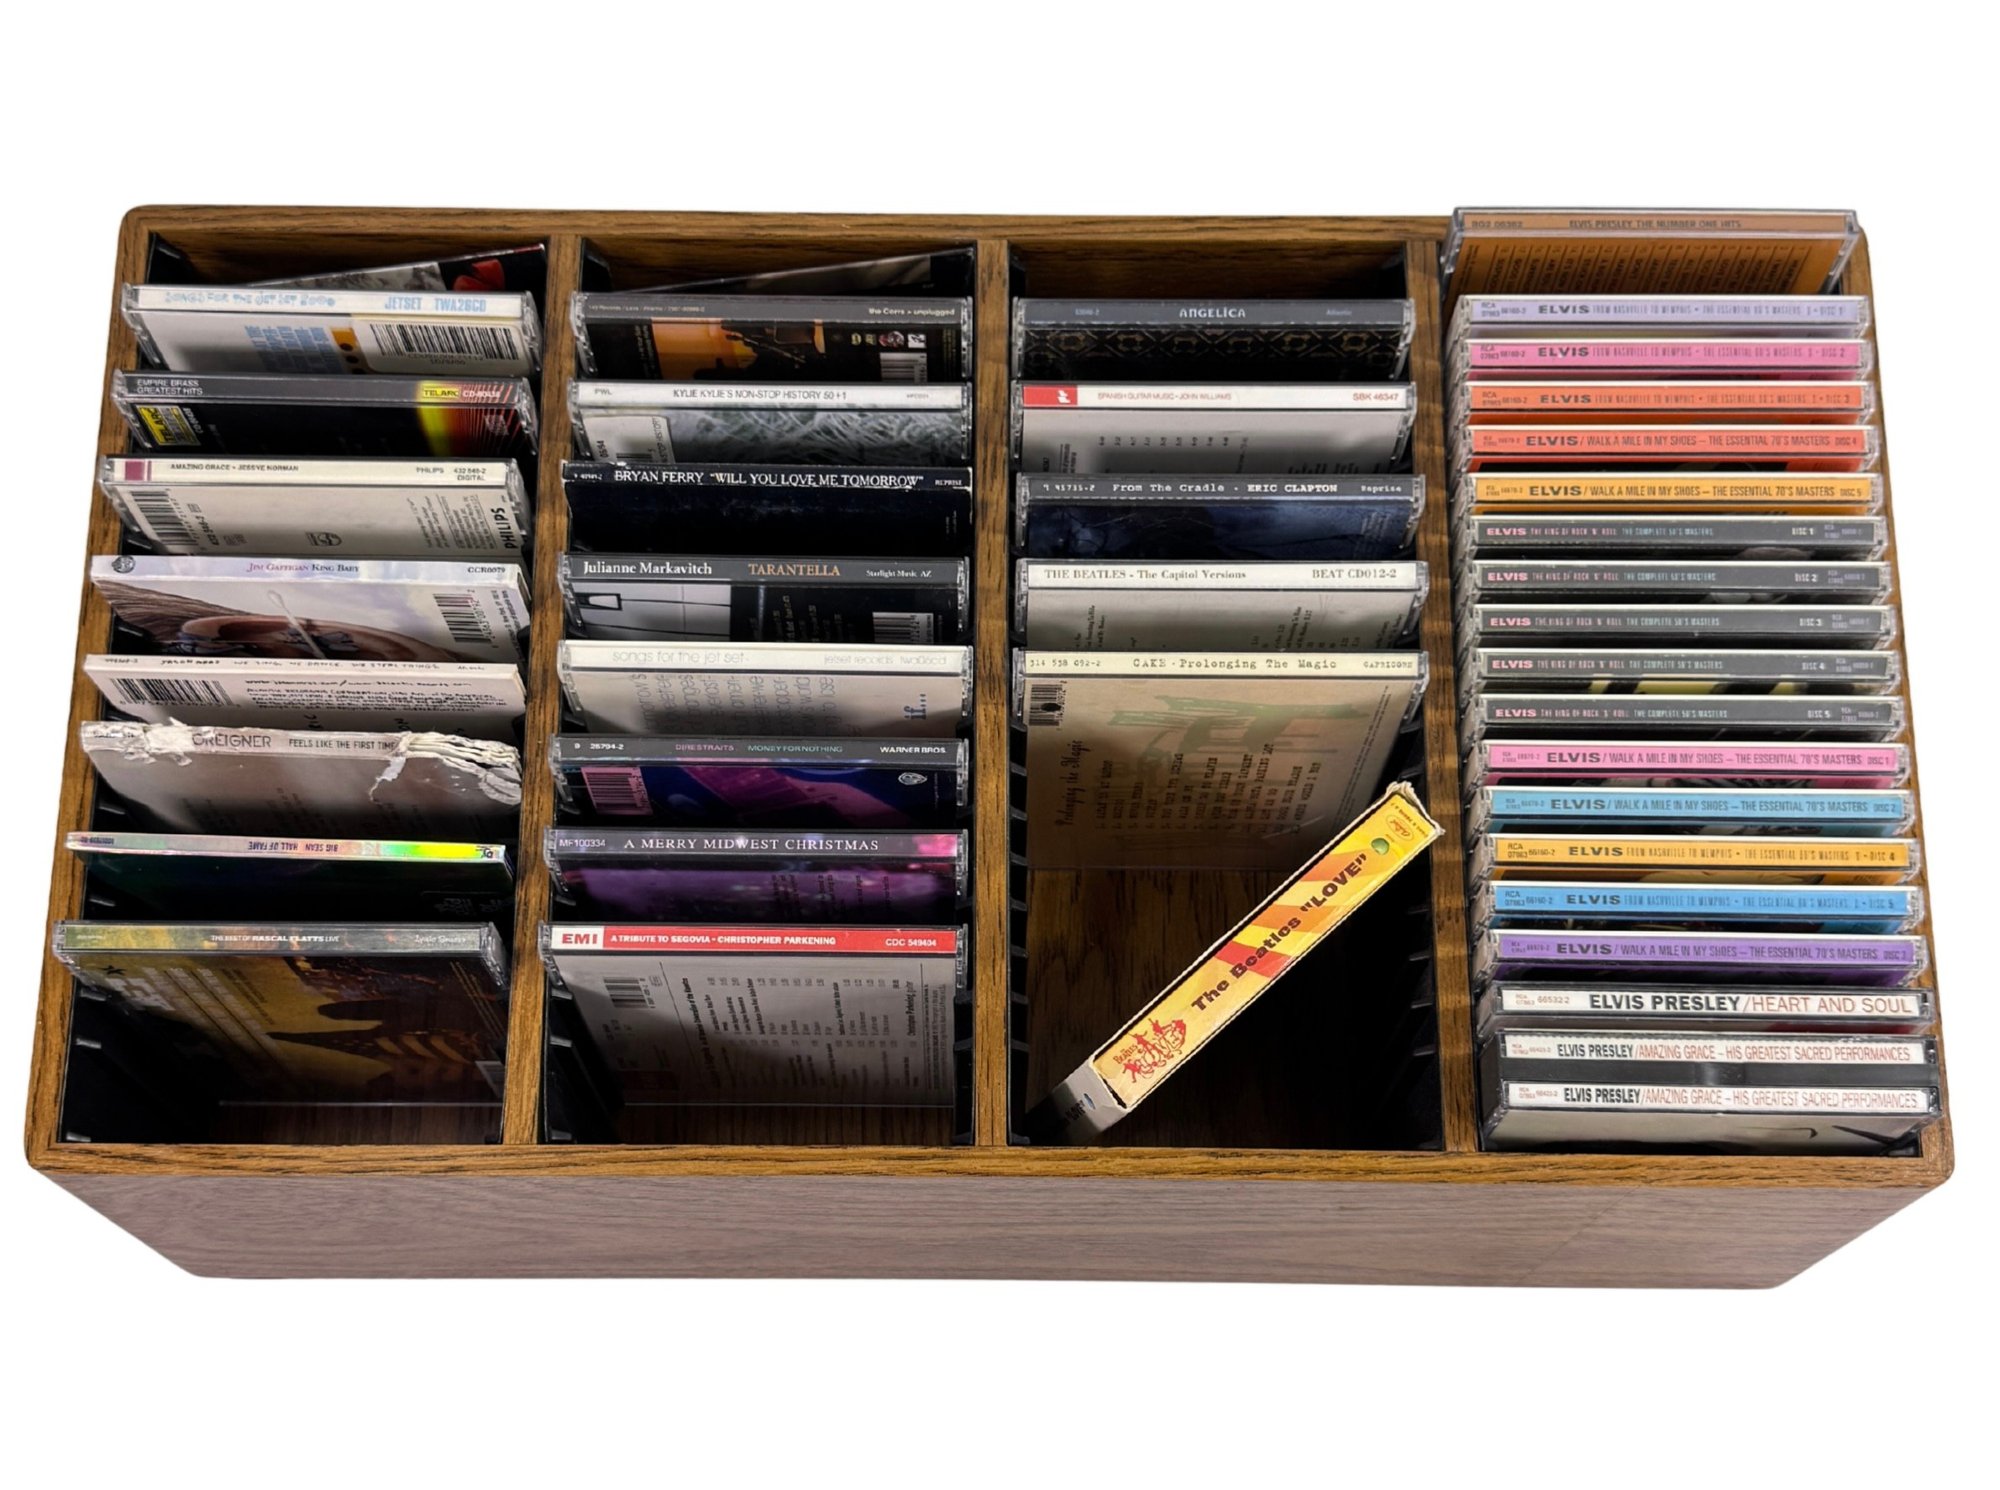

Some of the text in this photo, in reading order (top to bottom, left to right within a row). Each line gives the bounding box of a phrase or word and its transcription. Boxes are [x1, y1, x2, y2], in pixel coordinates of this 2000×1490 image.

[1595, 220, 1632, 228] PRESLEY
[384, 296, 422, 311] JETSET
[883, 307, 905, 315] Corrs
[913, 307, 955, 317] unplugged
[1538, 304, 1590, 315] ELVIS
[137, 378, 199, 388] EMPIRE BRASS
[136, 386, 203, 396] GREATEST HITS
[423, 389, 459, 398] TELARC
[673, 389, 698, 399] KYLIE
[735, 389, 782, 400] NON-STOP
[783, 390, 822, 400] HISTORY
[1540, 394, 1592, 405] ELVIS
[170, 463, 204, 471] AMAZING
[237, 464, 266, 472] JESSYE
[267, 465, 299, 473] NORMAN
[457, 474, 486, 482] DIGITAL
[614, 470, 660, 483] BRYAN
[662, 471, 705, 484] FERRY
[749, 473, 778, 485] YOU
[781, 474, 816, 486] LOVE
[819, 474, 839, 486] ME
[1112, 483, 1338, 493] From The Cradle ERIC CLAPTON
[490, 507, 519, 549] PHILIPS
[1486, 527, 1527, 536] ELVIS
[311, 563, 335, 573] KING
[337, 564, 360, 573] BABY
[583, 561, 713, 575] Julianne Markavitch
[748, 563, 841, 577] TARANTELLA
[1312, 568, 1398, 579] BEAT CD012-2
[1043, 569, 1247, 582] THE BEATLES The Capitol Versions
[1490, 616, 1532, 627] ELVIS
[612, 649, 744, 665] songs for the jet set
[1132, 658, 1338, 672] CAKE Prolonging The Magic
[1495, 707, 1537, 718] ELVIS
[1807, 709, 1824, 719] DISC
[289, 737, 314, 749] FEELS
[315, 738, 334, 749] LIKE
[335, 739, 352, 750] THE
[353, 740, 375, 751] FIRST
[700, 743, 735, 752] STRAITS
[801, 745, 843, 753] NOTHING
[879, 746, 921, 754] WARNER
[1609, 752, 1635, 763] WALK
[1645, 752, 1667, 764] MILE
[1678, 752, 1694, 764] MY
[1696, 753, 1724, 764] SHOES
[1735, 753, 1752, 764] THE
[1753, 753, 1799, 765] ESSENTIAL
[1821, 754, 1862, 765] MASTERS
[1867, 755, 1885, 766] DISC
[1873, 803, 1891, 813] DISC
[248, 841, 339, 852] BIG SEAN HALL OF FAME
[623, 838, 880, 851] A MERRY MIDWEST CHRISTMAS
[1567, 846, 1624, 857] ELVIS
[1565, 894, 1621, 905] ELVIS
[252, 935, 340, 943] RASCAL FLATTS LIVE
[562, 932, 599, 945] EMI
[618, 934, 656, 944] TRIBUTE
[657, 935, 670, 944] TO
[670, 935, 711, 945] SEGOVIA
[717, 935, 784, 946] CHRISTOPHER
[784, 936, 837, 946] PARKENING
[885, 937, 906, 947] CDC
[1191, 978, 1230, 1012] The
[1229, 916, 1302, 979] Beatles
[1589, 993, 1645, 1010] ELVIS
[1816, 996, 1856, 1013] AND
[1861, 997, 1913, 1014] SOUL
[1556, 1043, 1586, 1058] ELVIS
[1683, 1045, 1716, 1060] GRACE
[1725, 1045, 1743, 1061] HIS
[1744, 1045, 1792, 1061] GREATEST
[1793, 1046, 1833, 1061] SACRED
[1834, 1046, 1911, 1062] PERFORMANCES
[1563, 1086, 1592, 1103] ELVIS
[1841, 1091, 1918, 1108] PERFORMANCES
